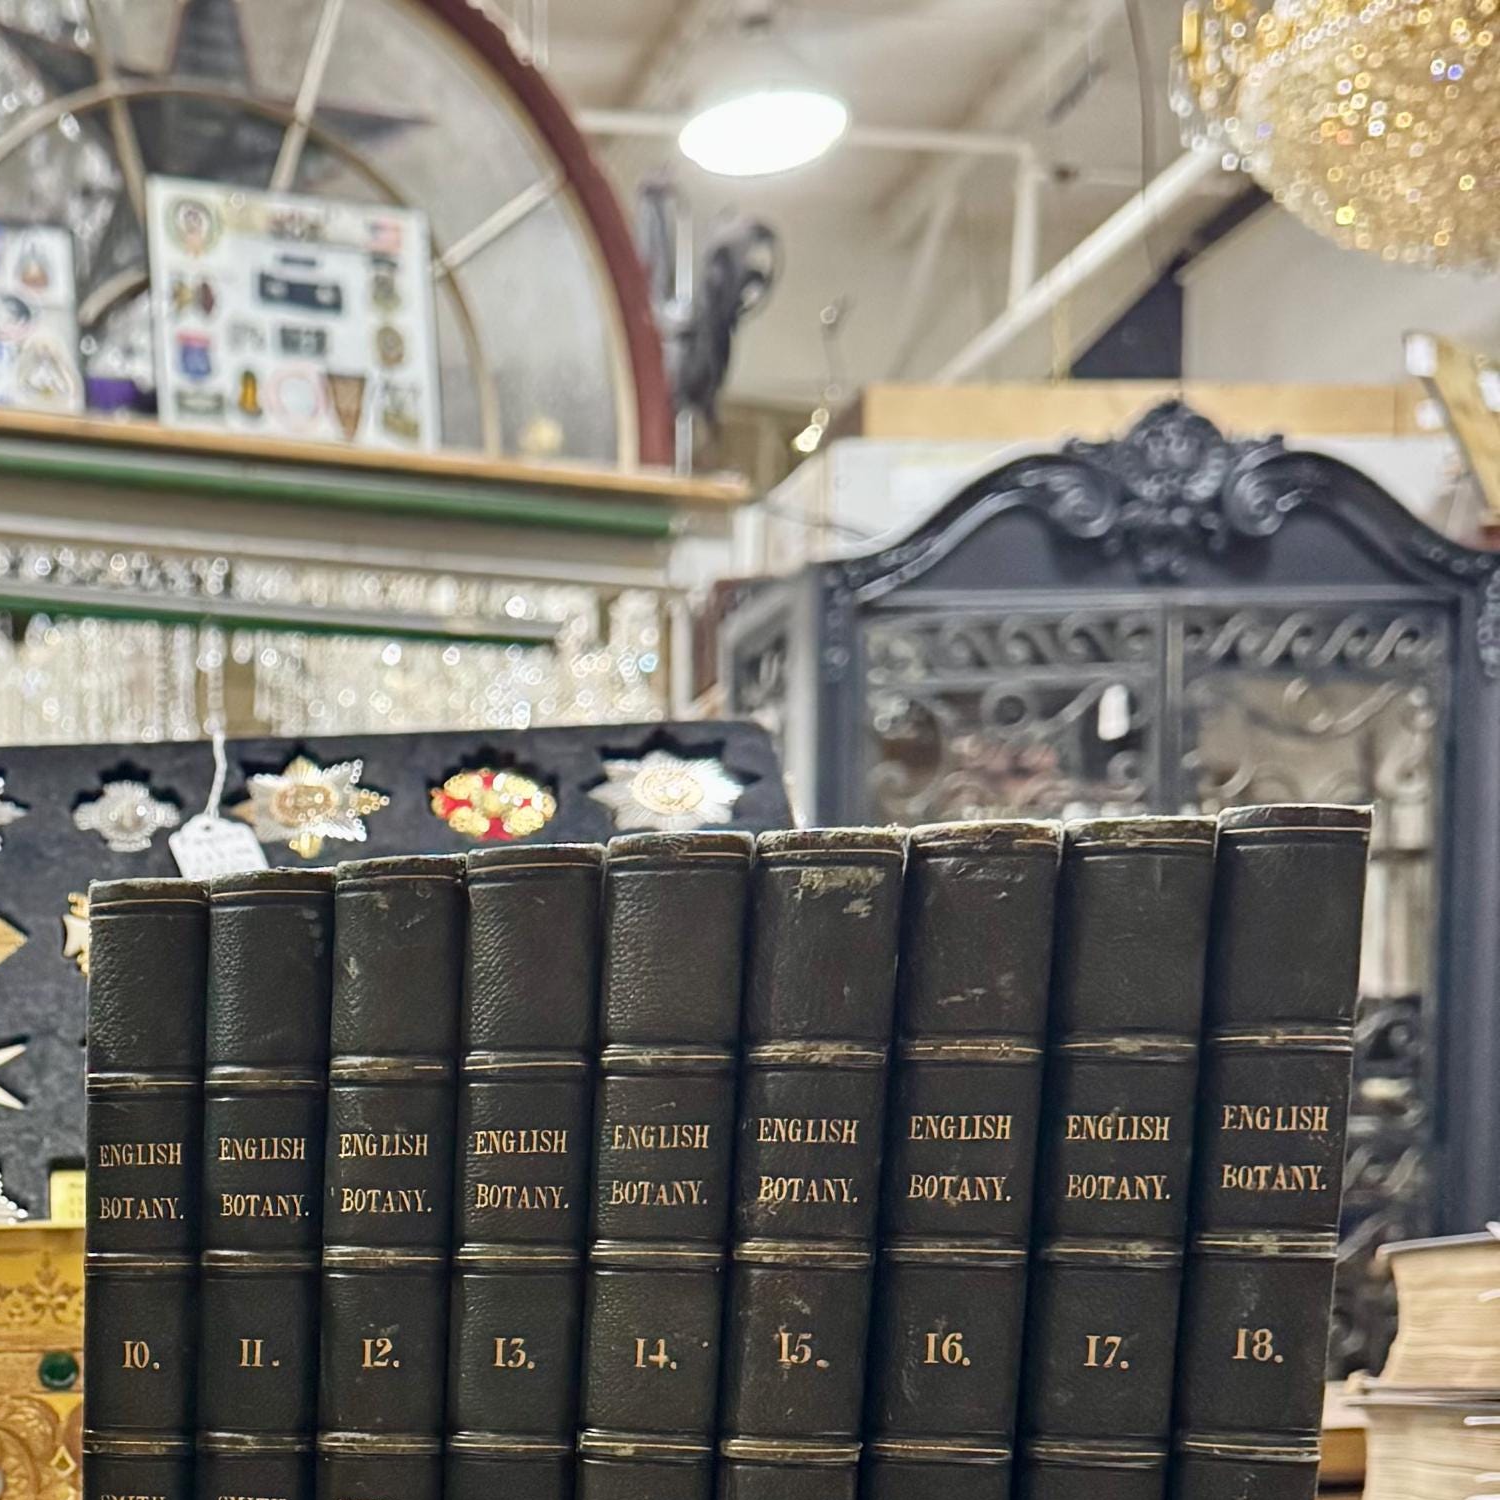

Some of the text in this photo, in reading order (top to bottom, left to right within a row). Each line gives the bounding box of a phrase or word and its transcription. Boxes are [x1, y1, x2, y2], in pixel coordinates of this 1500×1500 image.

[910, 1115, 1012, 1141] ENGLISH
[1065, 1115, 1170, 1141] ENGLISH
[1222, 1105, 1328, 1132] ENGLISH
[475, 1130, 568, 1154] ENGLISH
[612, 1125, 709, 1150] ENGLISH
[757, 1119, 858, 1145] ENGLISH
[99, 1142, 182, 1166] ENGLISH
[219, 1138, 306, 1161] ENGLISH
[339, 1133, 429, 1158] ENGLISH
[908, 1175, 1011, 1202] BOTANY.
[1066, 1175, 1170, 1201] BOTANY.
[1222, 1164, 1326, 1191] BOTANY.
[341, 1188, 432, 1214] BOTANY.
[476, 1185, 569, 1210] BOTANY.
[610, 1181, 708, 1206] BOTANY.
[759, 1177, 858, 1204] BOTANY.
[99, 1198, 184, 1221] BOTANY.
[221, 1193, 309, 1217] BOTANY.
